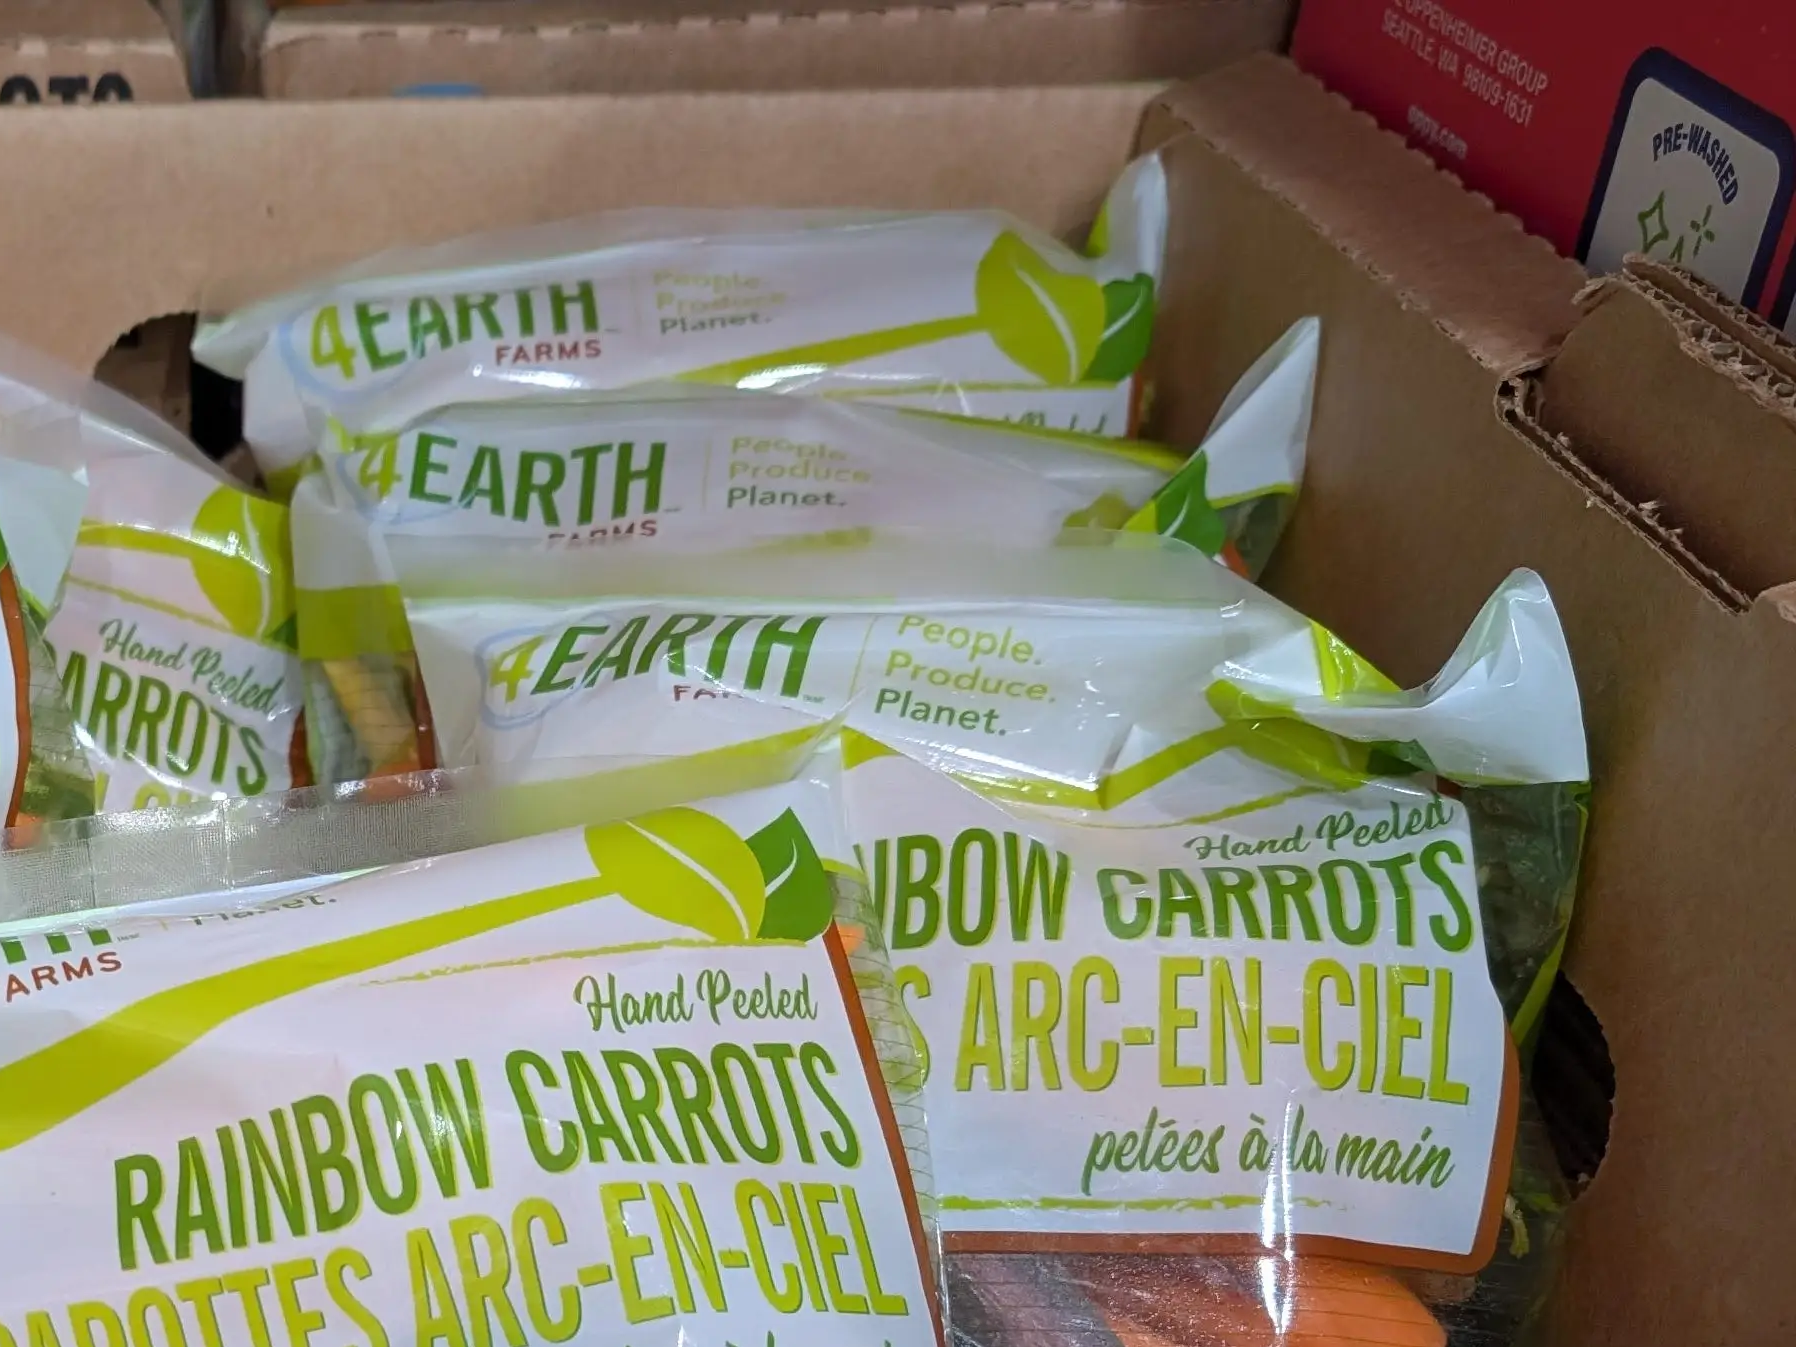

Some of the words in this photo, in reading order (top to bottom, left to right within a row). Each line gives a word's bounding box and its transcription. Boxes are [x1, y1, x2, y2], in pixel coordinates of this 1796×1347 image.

[1437, 44, 1460, 76] WA
[1463, 63, 1533, 127] 98109-1631
[1497, 50, 1549, 96] GROUP
[1652, 122, 1739, 206] PRE-WASHED
[495, 338, 603, 367] FARMS
[660, 312, 773, 335] Planet.
[726, 485, 847, 509] Planet.
[99, 618, 188, 671] Hand
[190, 645, 286, 714] Peeled
[489, 613, 828, 704] 4EARTH
[885, 650, 1056, 704] Produce.
[898, 614, 1042, 666] People.
[47, 640, 268, 797] ARROTS
[873, 687, 1008, 737] Planet.
[1182, 832, 1311, 862] Hand
[1316, 797, 1454, 851] Peeled
[853, 827, 1072, 950] NBOW
[1097, 839, 1475, 954] CARROTS
[572, 973, 696, 1034] Hand
[696, 967, 818, 1028] Peeled
[954, 955, 1470, 1105] ARC-EN-CIEL
[114, 1058, 493, 1272] RAINBOW
[504, 1041, 860, 1176] CARROTS
[1081, 1104, 1221, 1197] pelées
[1239, 1112, 1278, 1172] à
[1325, 1125, 1456, 1189] main
